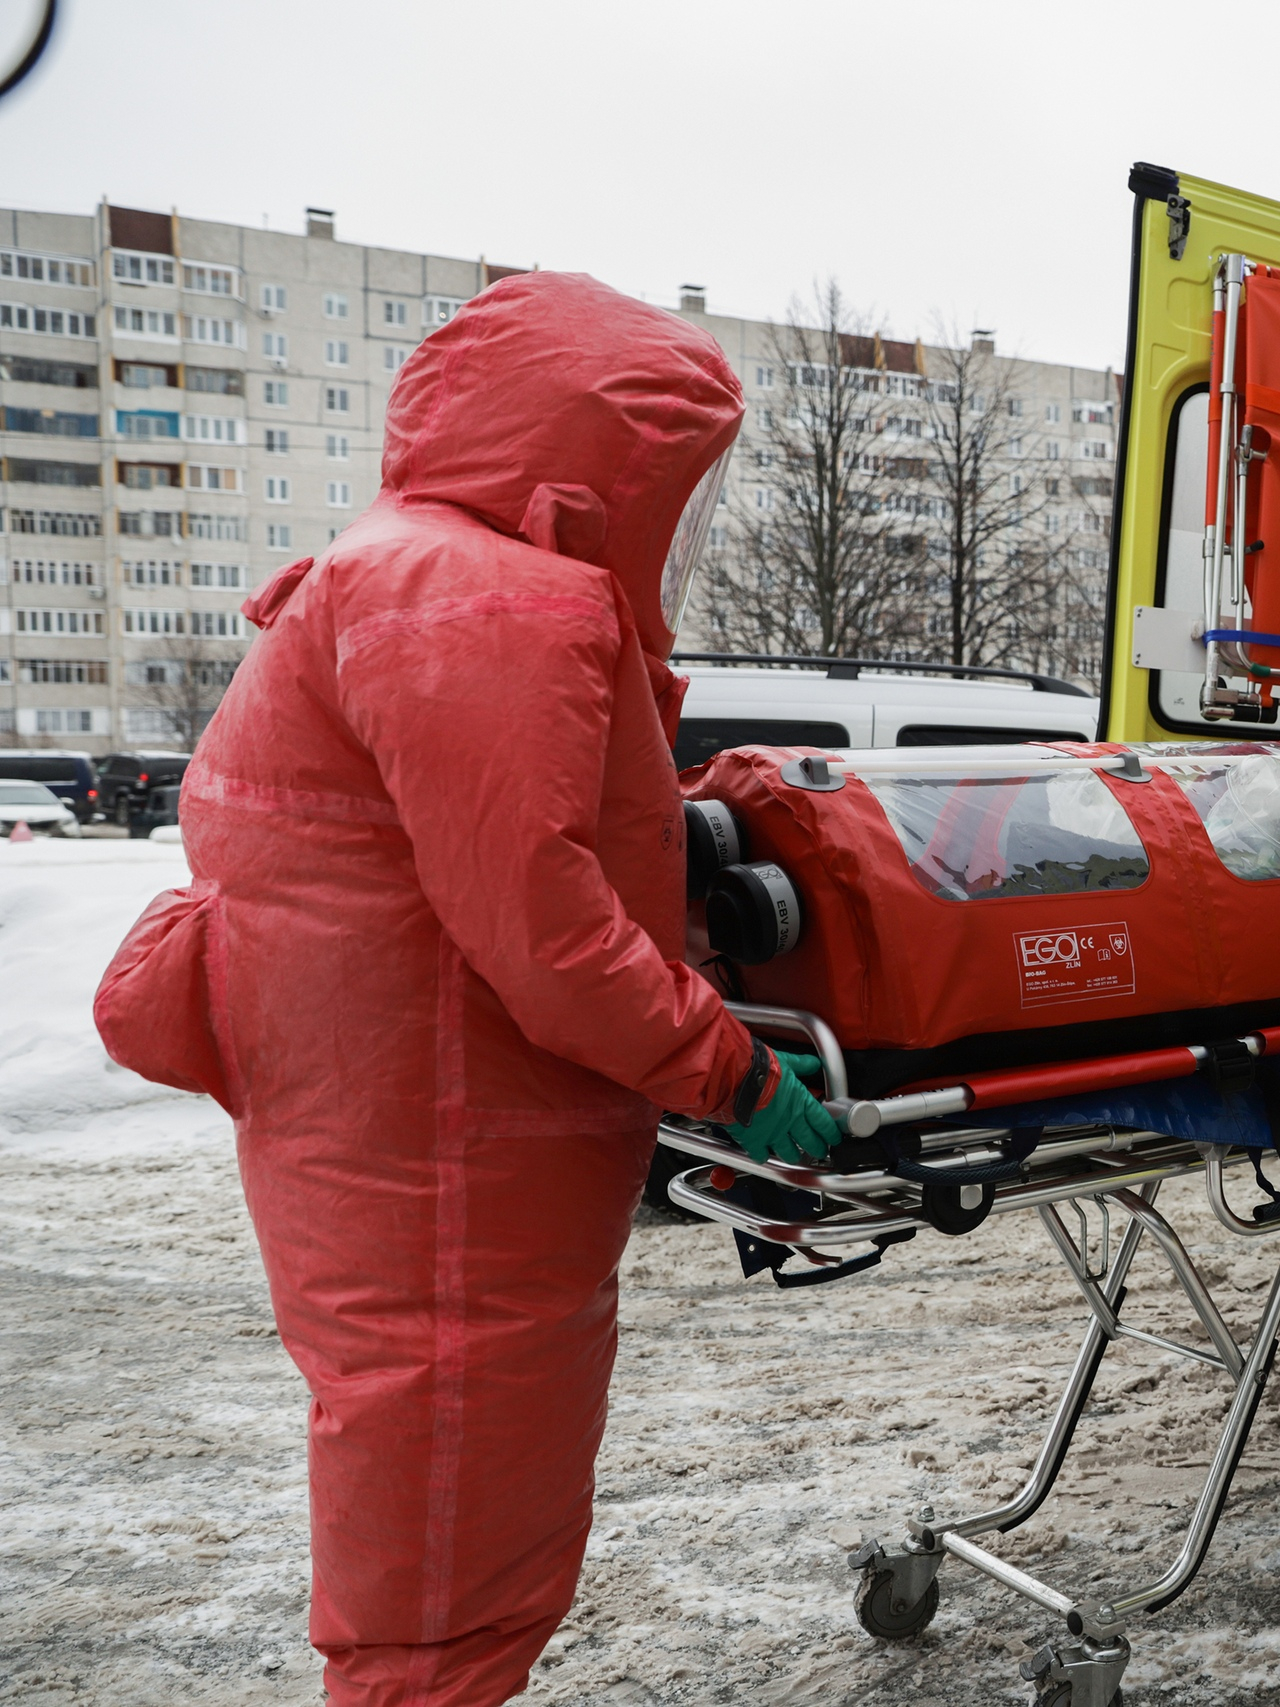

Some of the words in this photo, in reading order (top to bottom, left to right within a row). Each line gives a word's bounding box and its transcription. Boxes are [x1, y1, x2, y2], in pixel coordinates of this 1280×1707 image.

[709, 816, 725, 838] EBV
[776, 900, 789, 925] EBV
[1020, 932, 1079, 966] EGO
